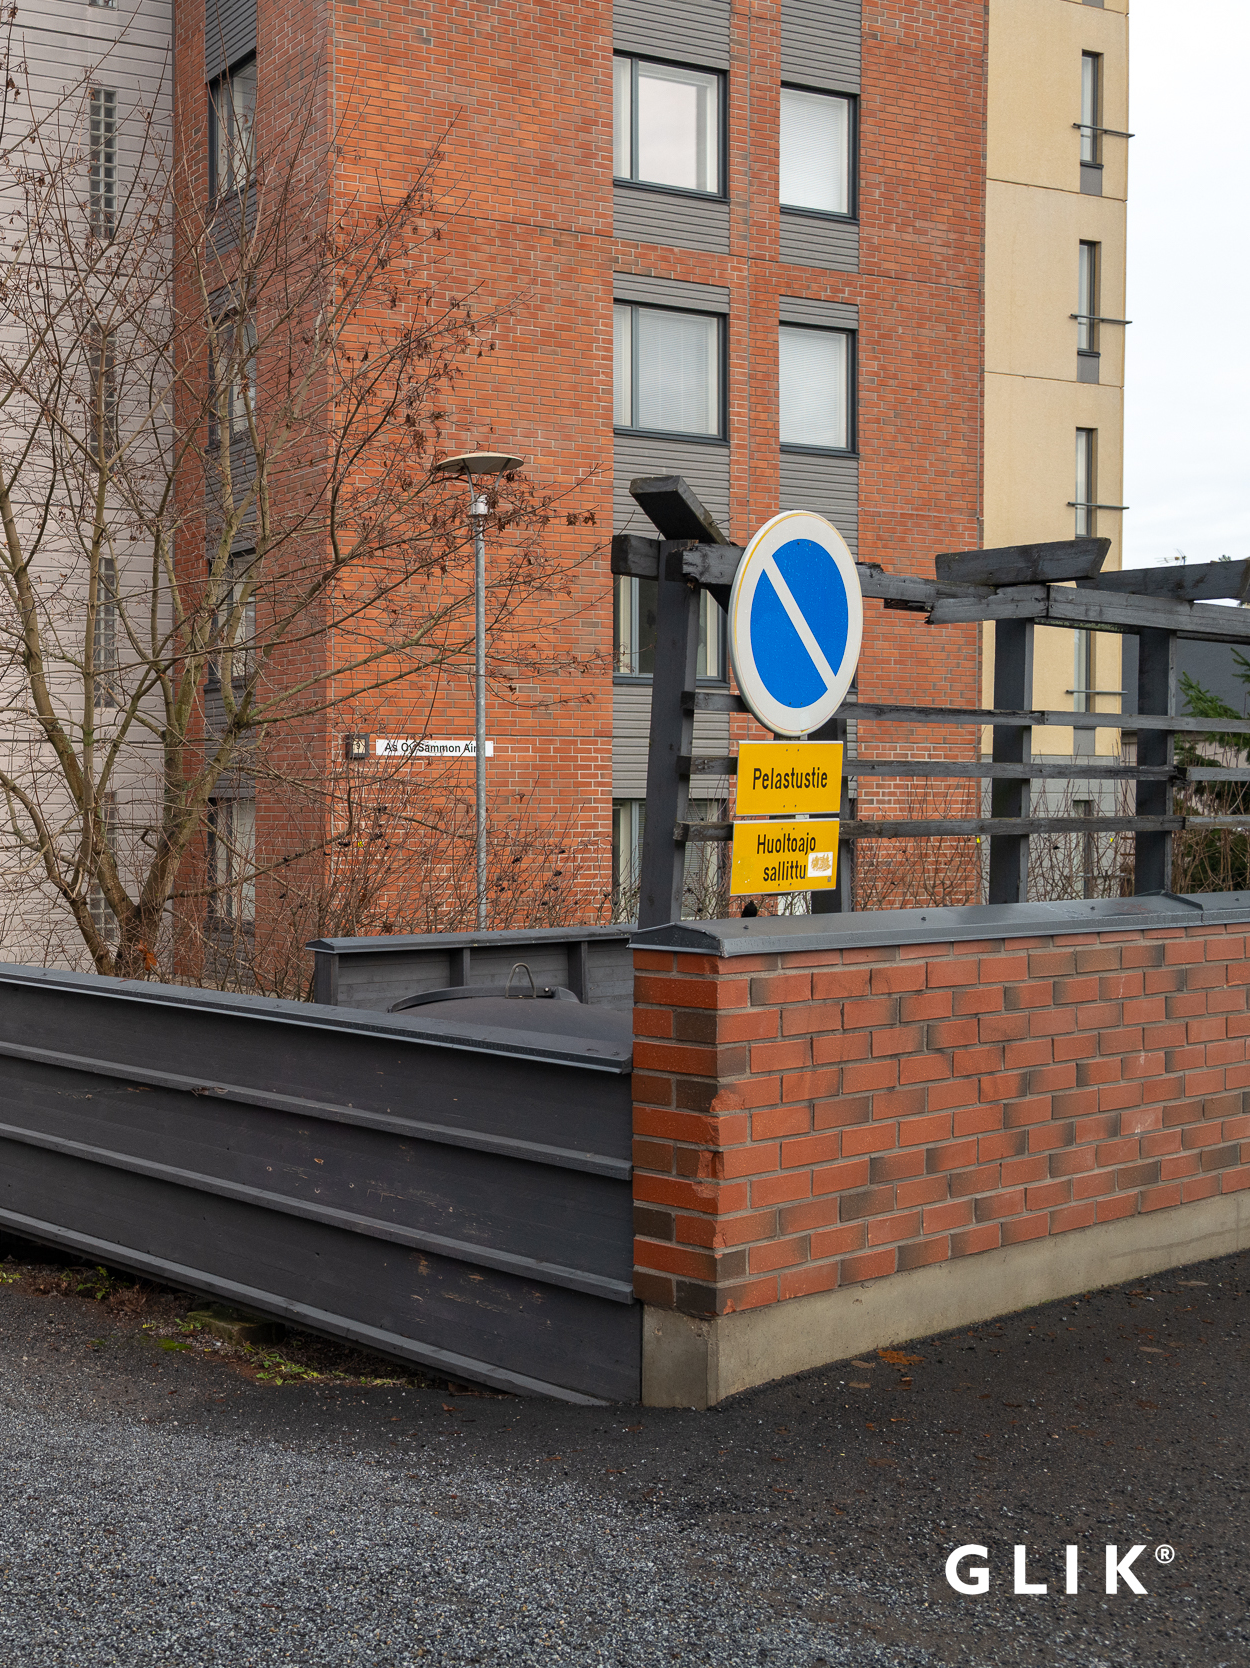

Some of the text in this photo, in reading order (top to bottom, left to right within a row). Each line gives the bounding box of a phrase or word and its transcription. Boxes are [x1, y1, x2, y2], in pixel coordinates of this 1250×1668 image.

[385, 743, 398, 752] As
[418, 743, 461, 753] Sammon
[753, 767, 828, 790] Pelastustie
[757, 832, 817, 855] Huoltoajo
[763, 860, 807, 882] sallittu
